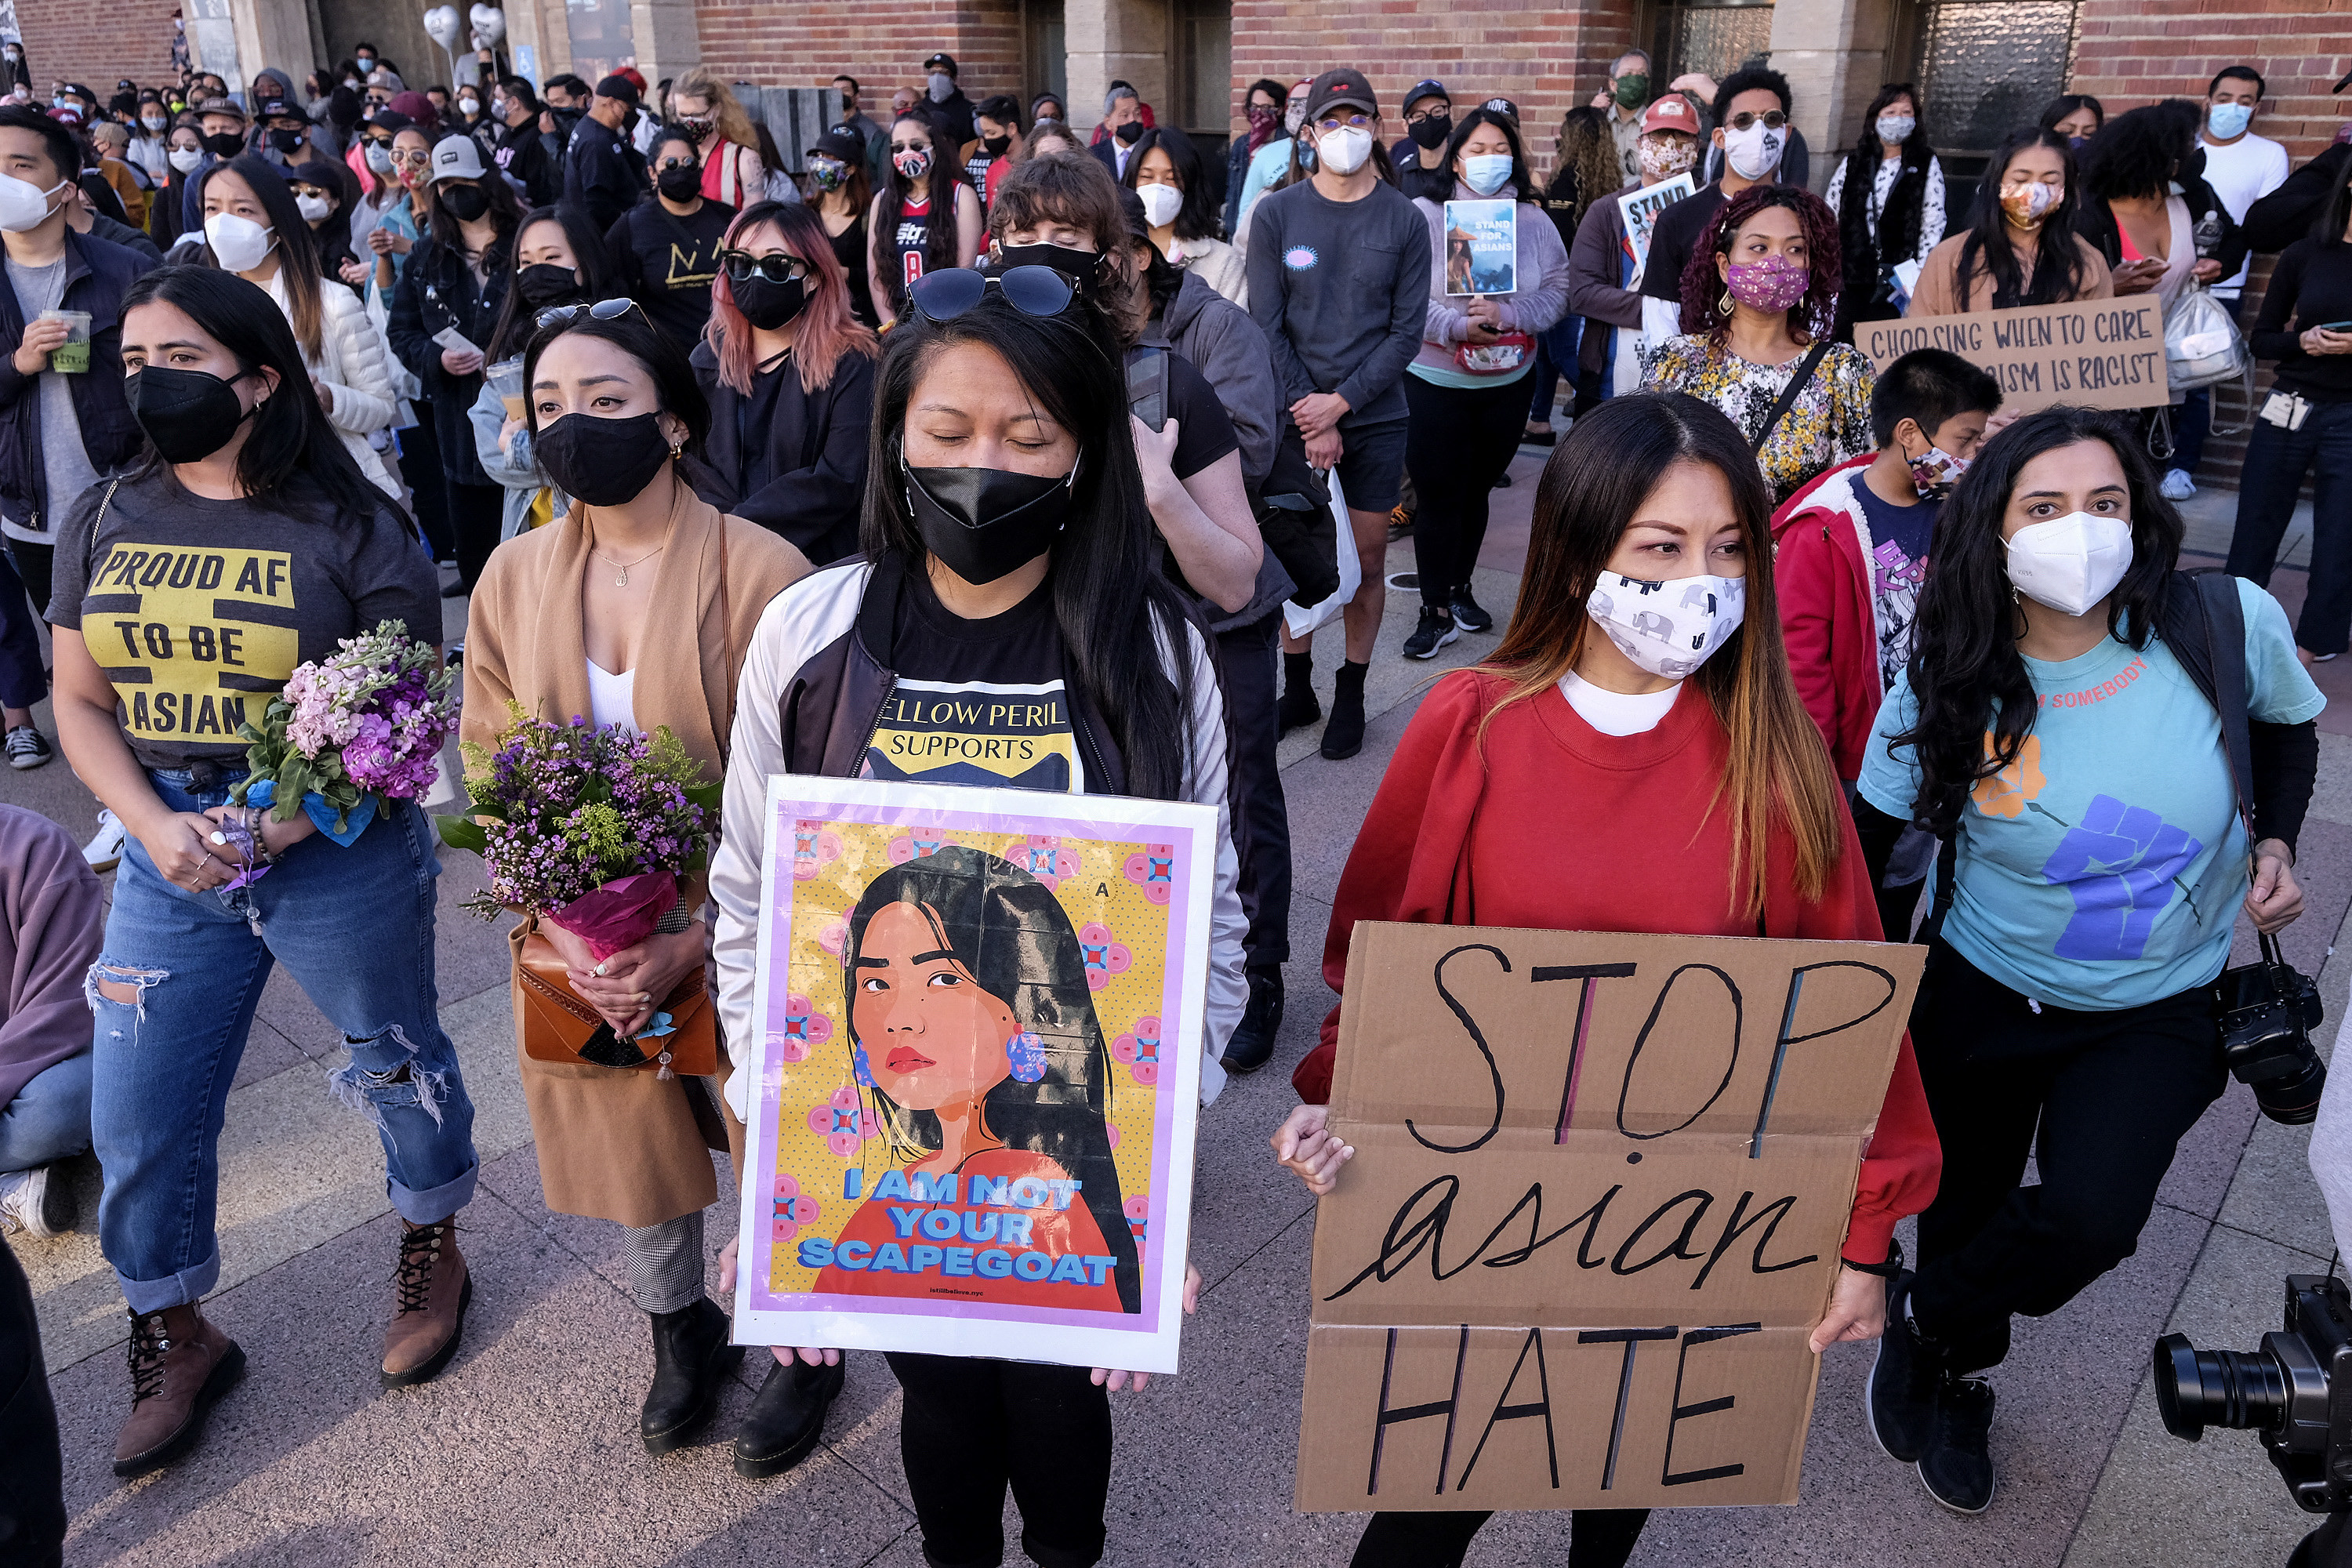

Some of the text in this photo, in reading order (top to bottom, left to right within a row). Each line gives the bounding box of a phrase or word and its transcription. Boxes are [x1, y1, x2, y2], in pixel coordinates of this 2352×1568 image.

[1475, 220, 1511, 230] STAND
[1629, 186, 1687, 224] STAND
[1474, 243, 1512, 252] ASIANS
[1480, 231, 1502, 240] FOR
[1871, 307, 2152, 360] CHOOSING WHEN TO CARE
[2052, 360, 2072, 391] IS
[2078, 352, 2159, 390] RACIST
[96, 550, 287, 597] PROUD AF
[114, 622, 245, 666] TO BE
[2053, 656, 2148, 708] SOMEBODY
[133, 691, 246, 735] ASIAN
[989, 702, 1066, 727] PERIL
[890, 735, 1034, 760] SUPPORTS
[1095, 882, 1109, 898] A
[1405, 943, 1896, 1160] STOP
[844, 1167, 1083, 1210] I AM NOT
[885, 1206, 1035, 1245] YOUR
[1323, 1151, 1819, 1301] asian
[797, 1237, 1118, 1287] SCAPEGOAT
[1367, 1322, 1762, 1497] HATE
